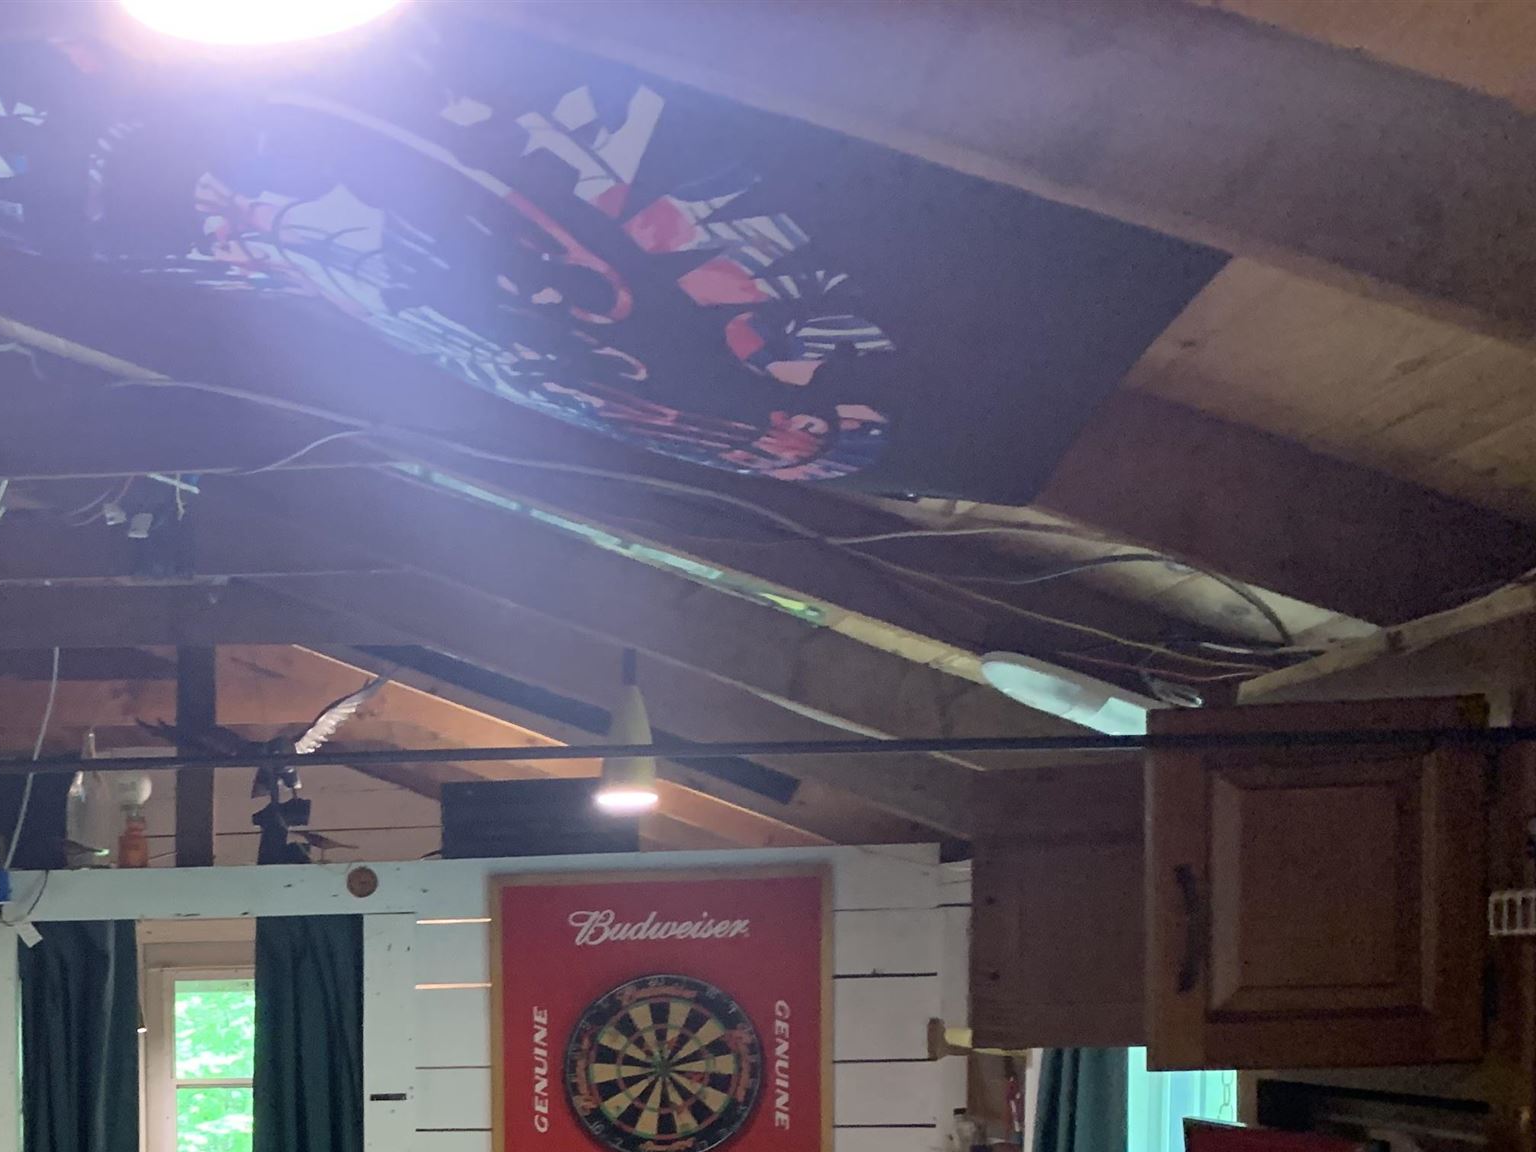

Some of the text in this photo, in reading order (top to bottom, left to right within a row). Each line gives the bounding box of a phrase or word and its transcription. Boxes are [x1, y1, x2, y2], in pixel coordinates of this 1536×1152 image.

[568, 909, 750, 946] Budweiser
[533, 1005, 549, 1133] GENUINE
[774, 999, 791, 1130] GENUINE
